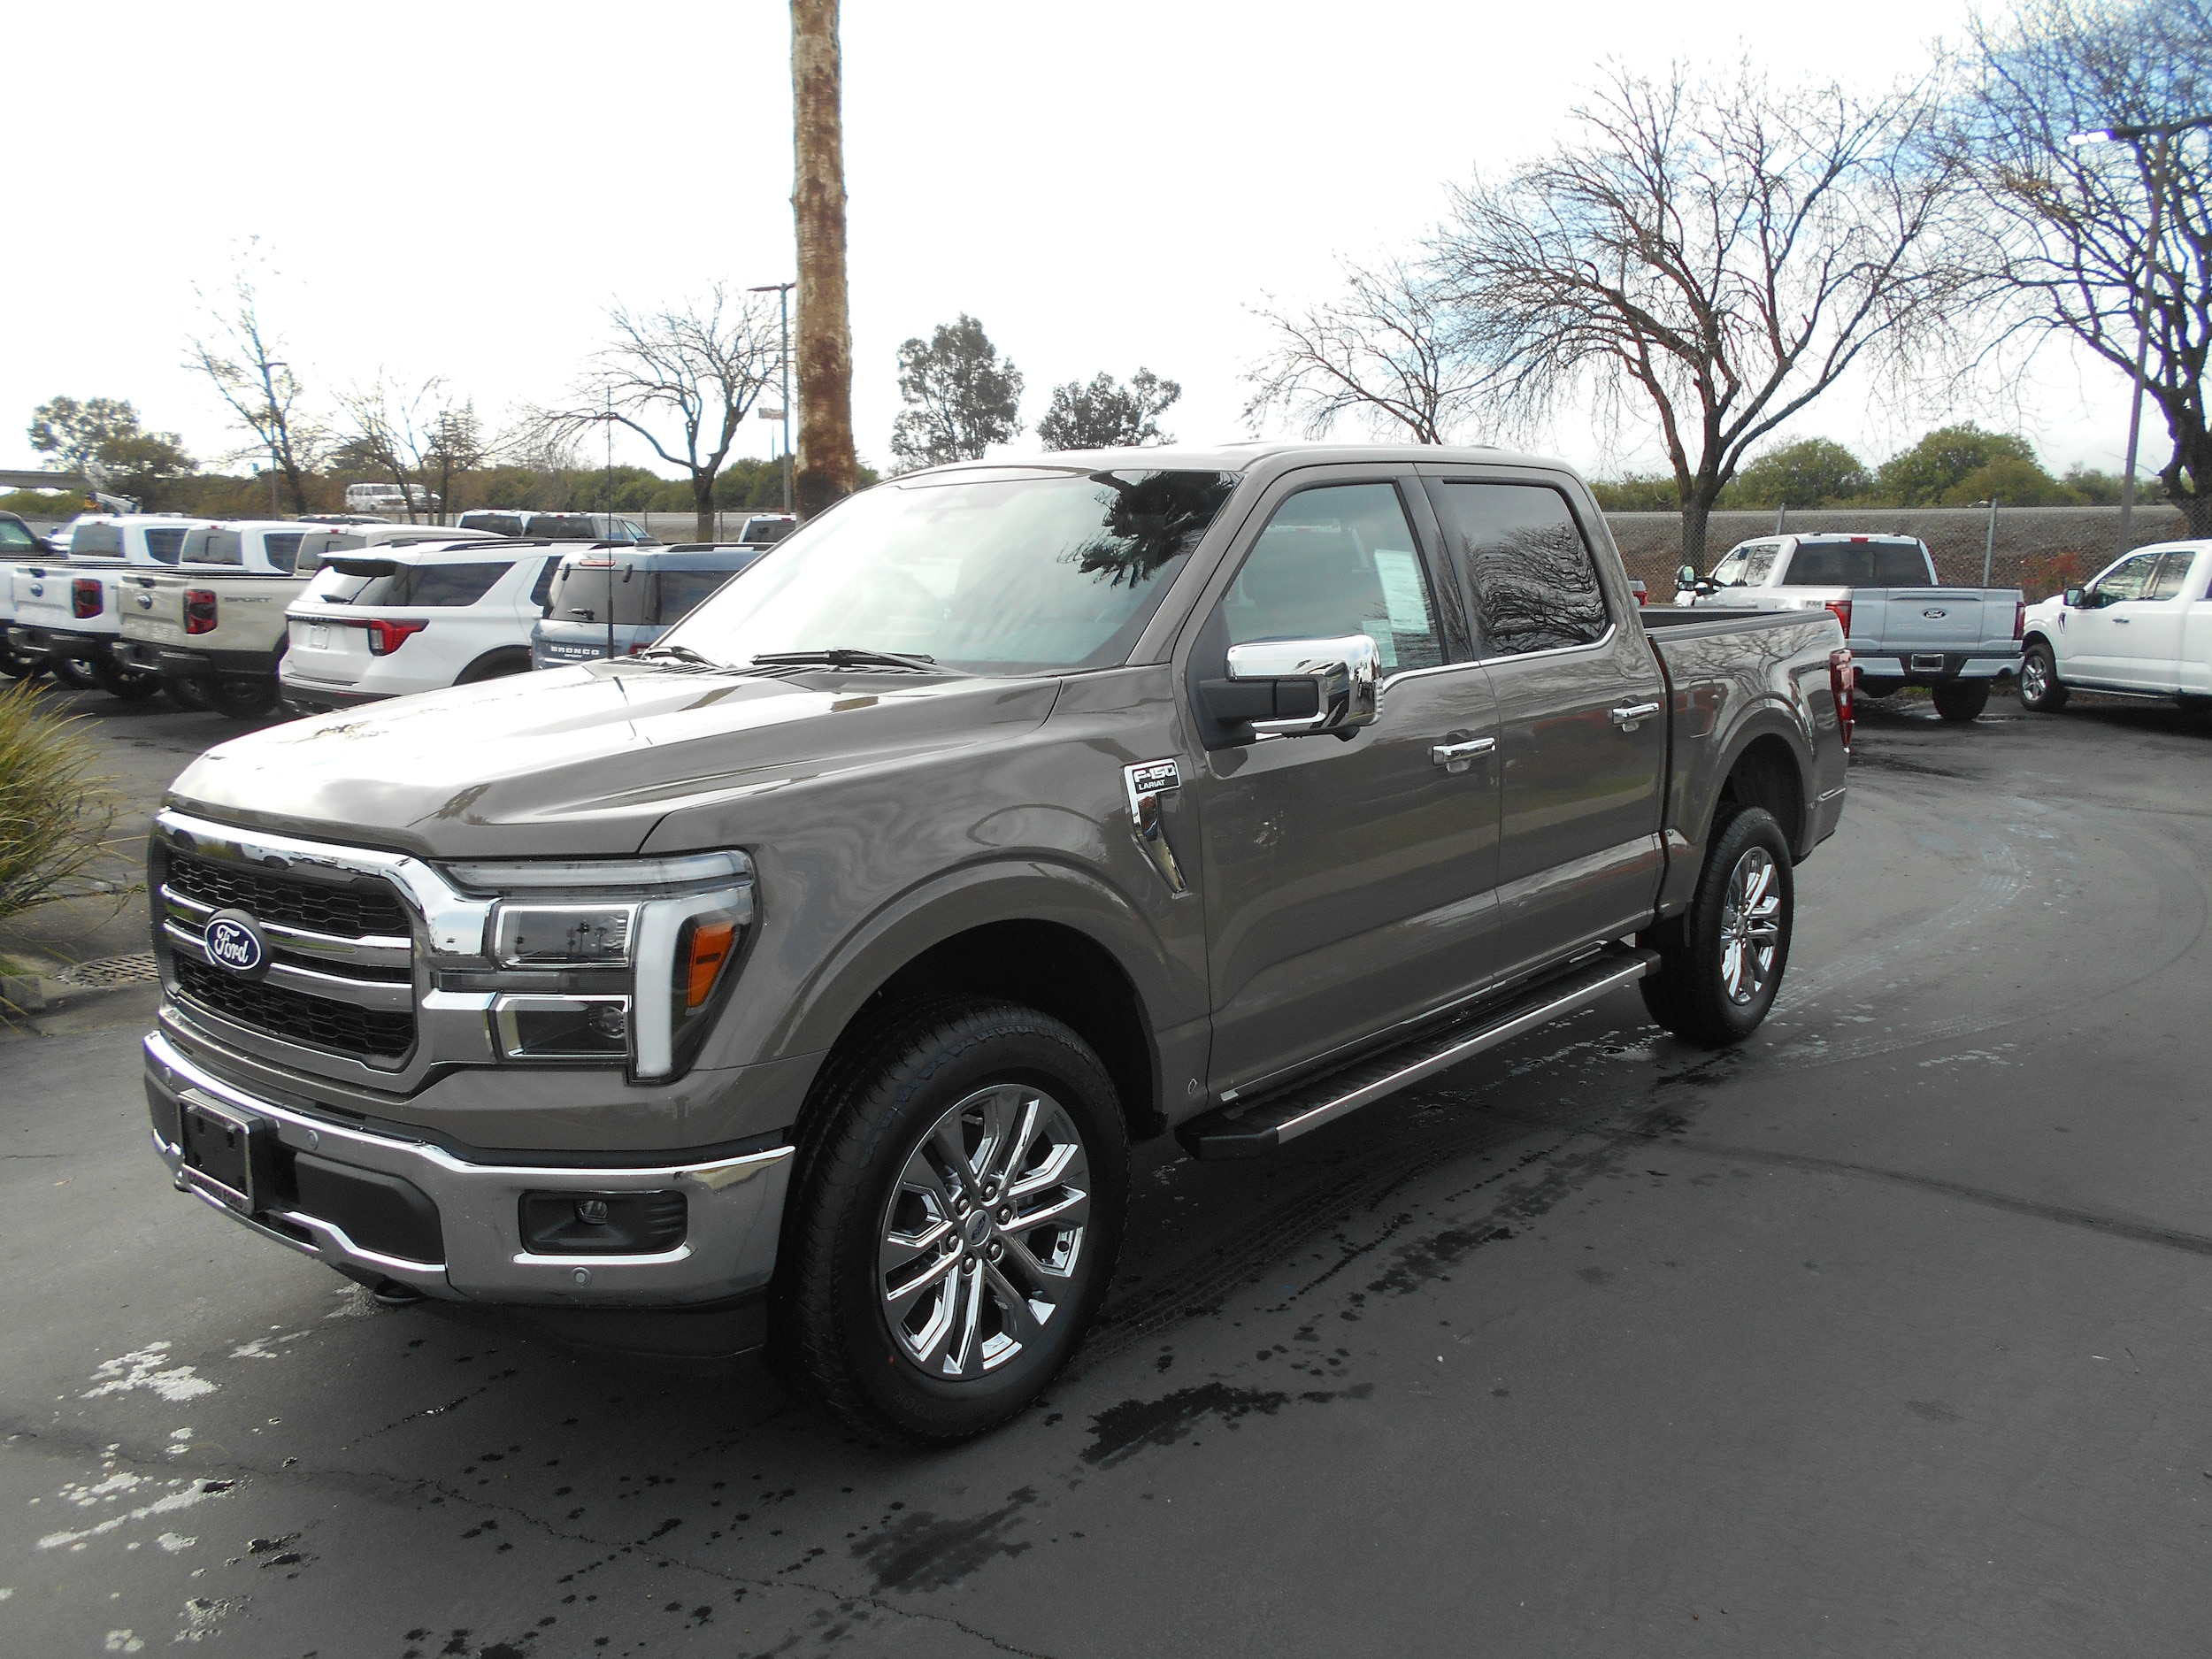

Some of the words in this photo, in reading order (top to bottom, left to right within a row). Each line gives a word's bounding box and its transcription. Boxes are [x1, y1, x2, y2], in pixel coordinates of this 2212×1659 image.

[550, 646, 600, 656] BRONCO
[1133, 764, 1177, 783] F-150
[1138, 779, 1166, 791] LARIAT
[214, 924, 250, 964] Ford
